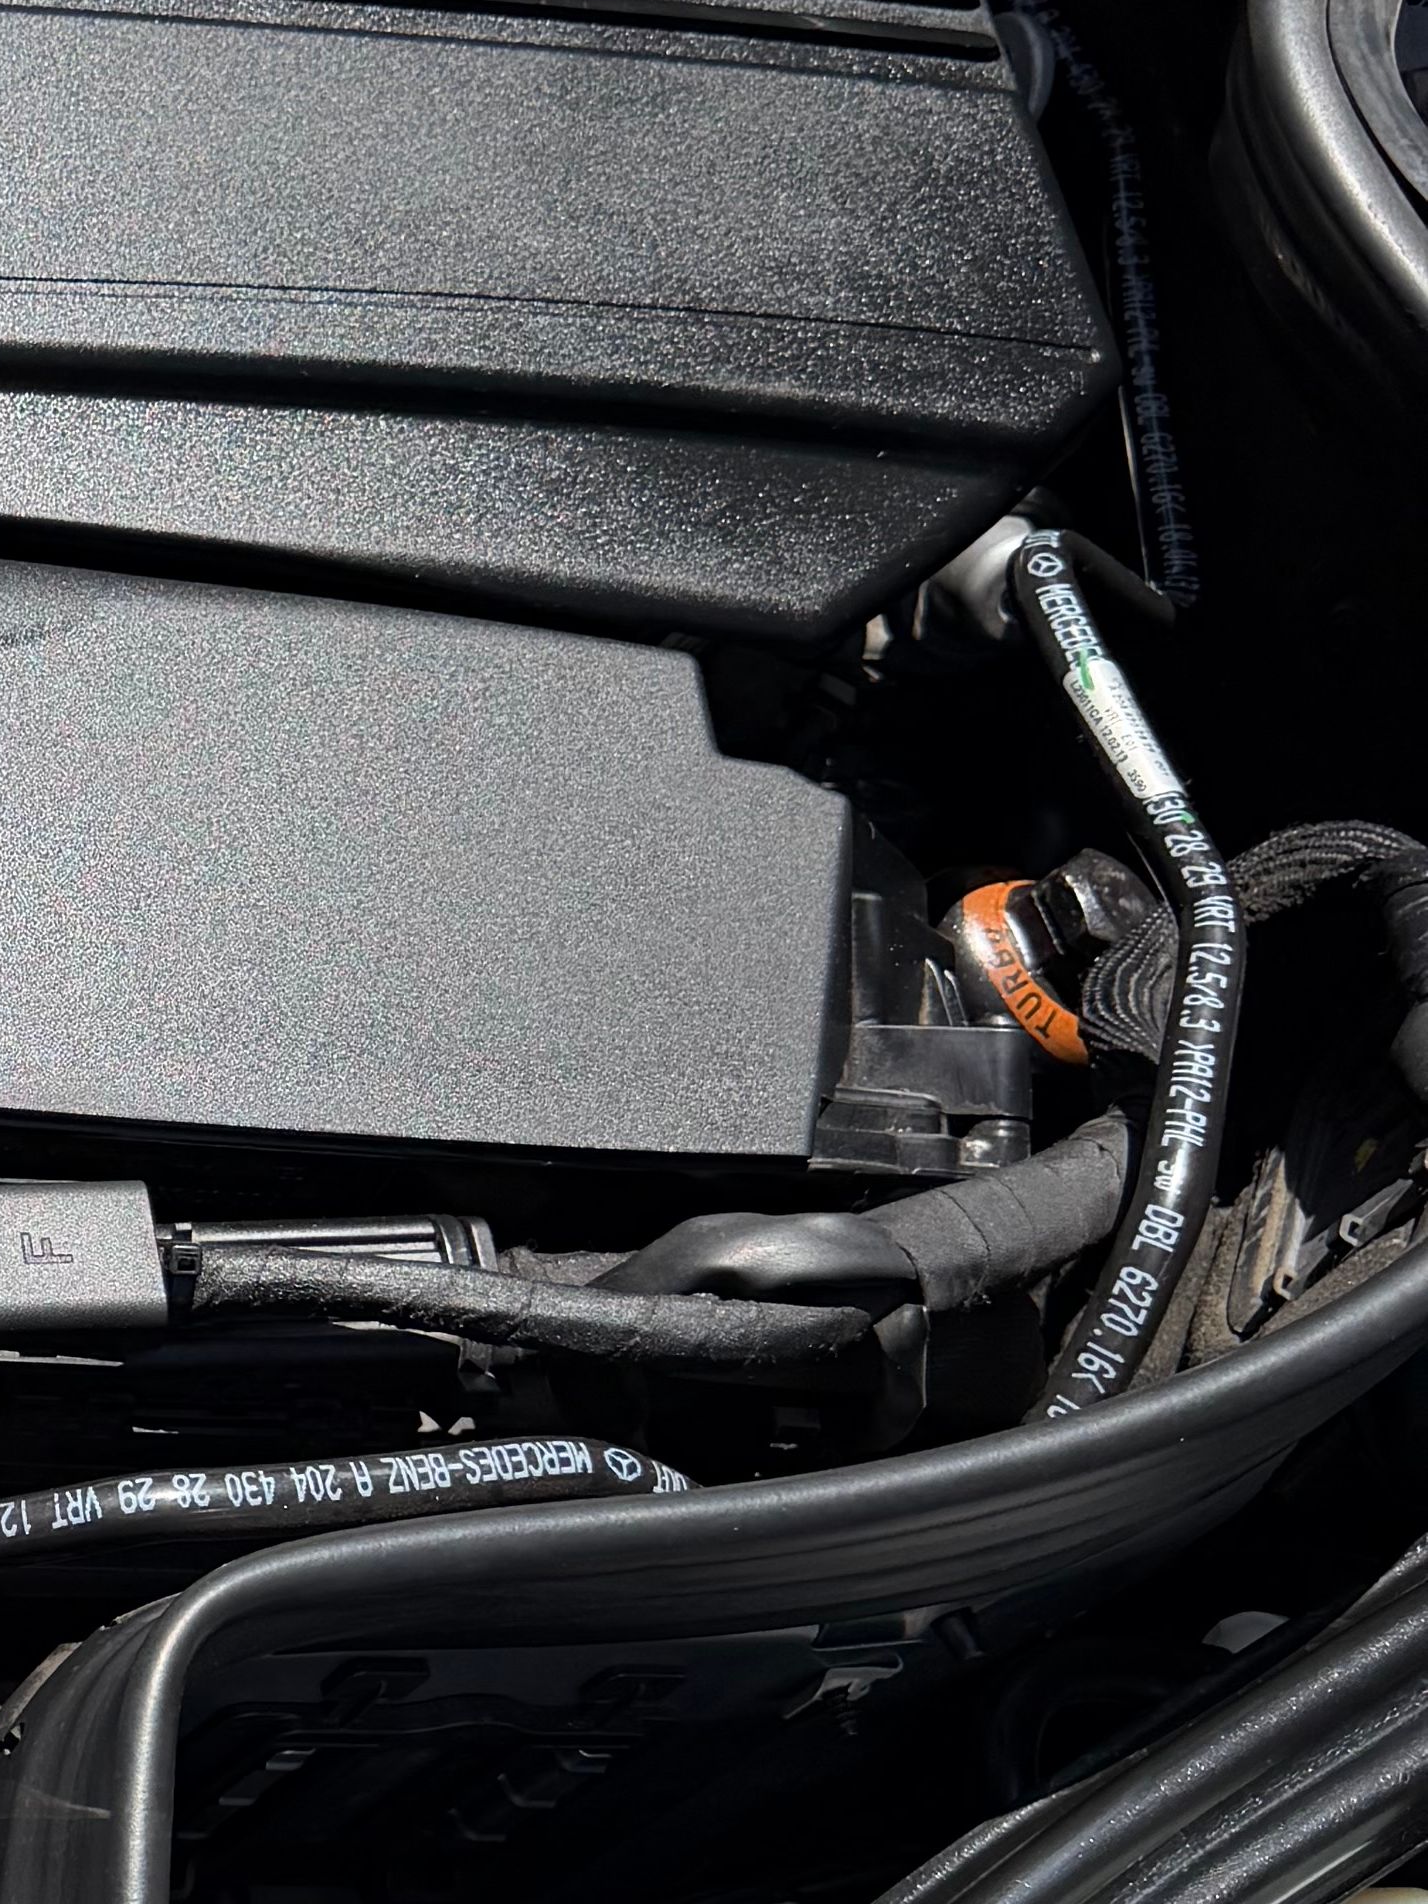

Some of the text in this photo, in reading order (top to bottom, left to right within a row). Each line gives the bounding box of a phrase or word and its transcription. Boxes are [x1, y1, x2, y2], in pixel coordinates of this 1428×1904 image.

[1164, 830, 1210, 857] 28
[1181, 861, 1228, 888] 29
[1193, 894, 1236, 933] VRT
[1131, 1204, 1186, 1253] DBL
[290, 1464, 344, 1502] 204
[349, 1461, 374, 1497] A
[380, 1441, 594, 1494] MERCEDES-BENZ
[118, 1479, 156, 1515] 29
[172, 1472, 212, 1508] 28
[224, 1470, 276, 1507] 430
[51, 1486, 104, 1529] VRT
